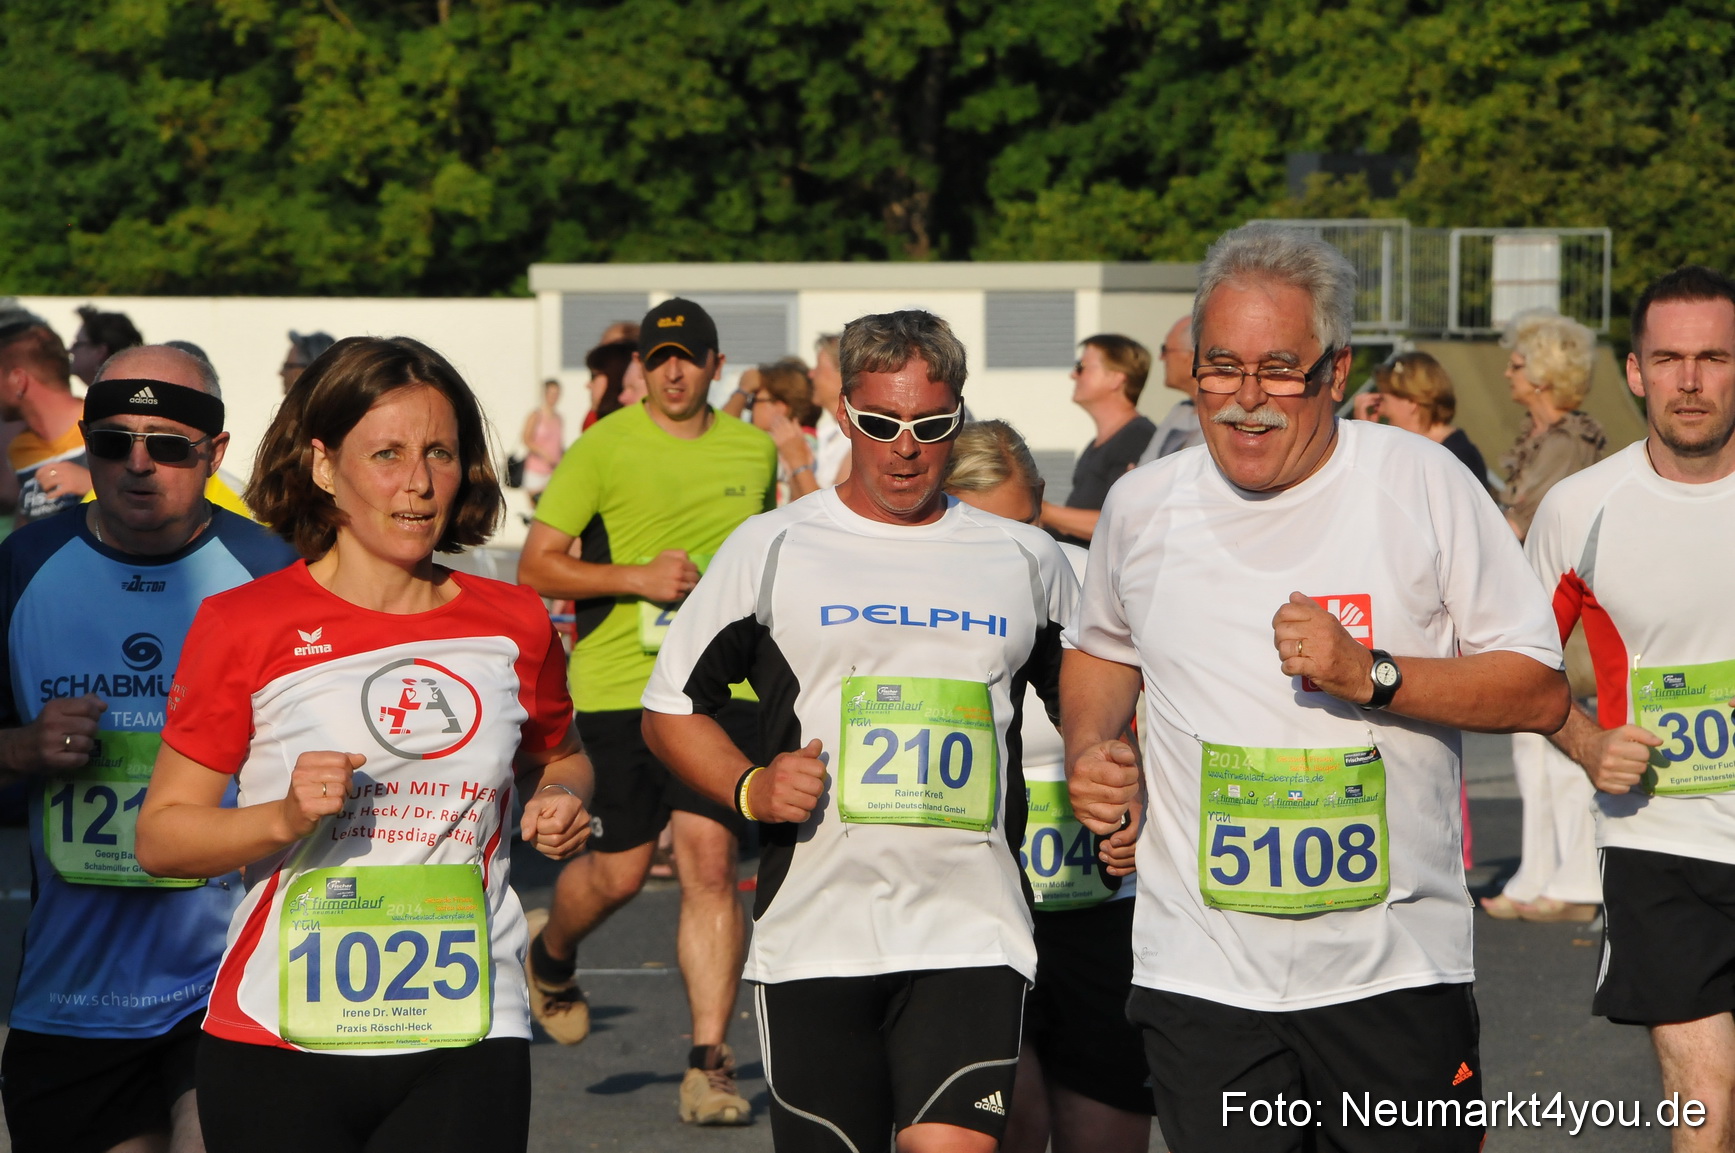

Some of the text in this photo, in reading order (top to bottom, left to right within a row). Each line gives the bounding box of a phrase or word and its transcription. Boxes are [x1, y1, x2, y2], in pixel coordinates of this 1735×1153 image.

[129, 397, 158, 405] adidas
[820, 604, 1007, 638] DELPHI
[294, 643, 333, 656] erima
[1655, 684, 1707, 697] firmenlauf
[865, 700, 923, 711] firmenlauf
[111, 711, 164, 727] TEAM
[1658, 708, 1735, 762] 30
[860, 728, 973, 789] 210
[1208, 751, 1253, 770] 2014
[1692, 764, 1717, 772] Oliver
[1670, 777, 1692, 785] Egner
[410, 781, 450, 797] MIT
[895, 789, 943, 799] Rainer Kreß
[1220, 795, 1259, 806] firmenlauf
[1276, 797, 1320, 807] firmenlauf
[1337, 792, 1379, 805] firmenlauf
[360, 805, 398, 817] Heck
[401, 804, 411, 820] /
[414, 807, 435, 820] Dr.
[867, 801, 966, 815] Delphi Deutschland GmbH
[95, 850, 120, 861] Georg
[1210, 823, 1378, 888] 5108
[84, 862, 130, 873] Schabmüller
[311, 895, 384, 911] firmenlauf
[386, 903, 424, 916] 2014
[289, 930, 480, 1003] 1025
[343, 1007, 427, 1018] Irene Dr. Walter
[336, 1022, 433, 1033] Praxis Röschl-Heck
[974, 1101, 1006, 1116] adidas
